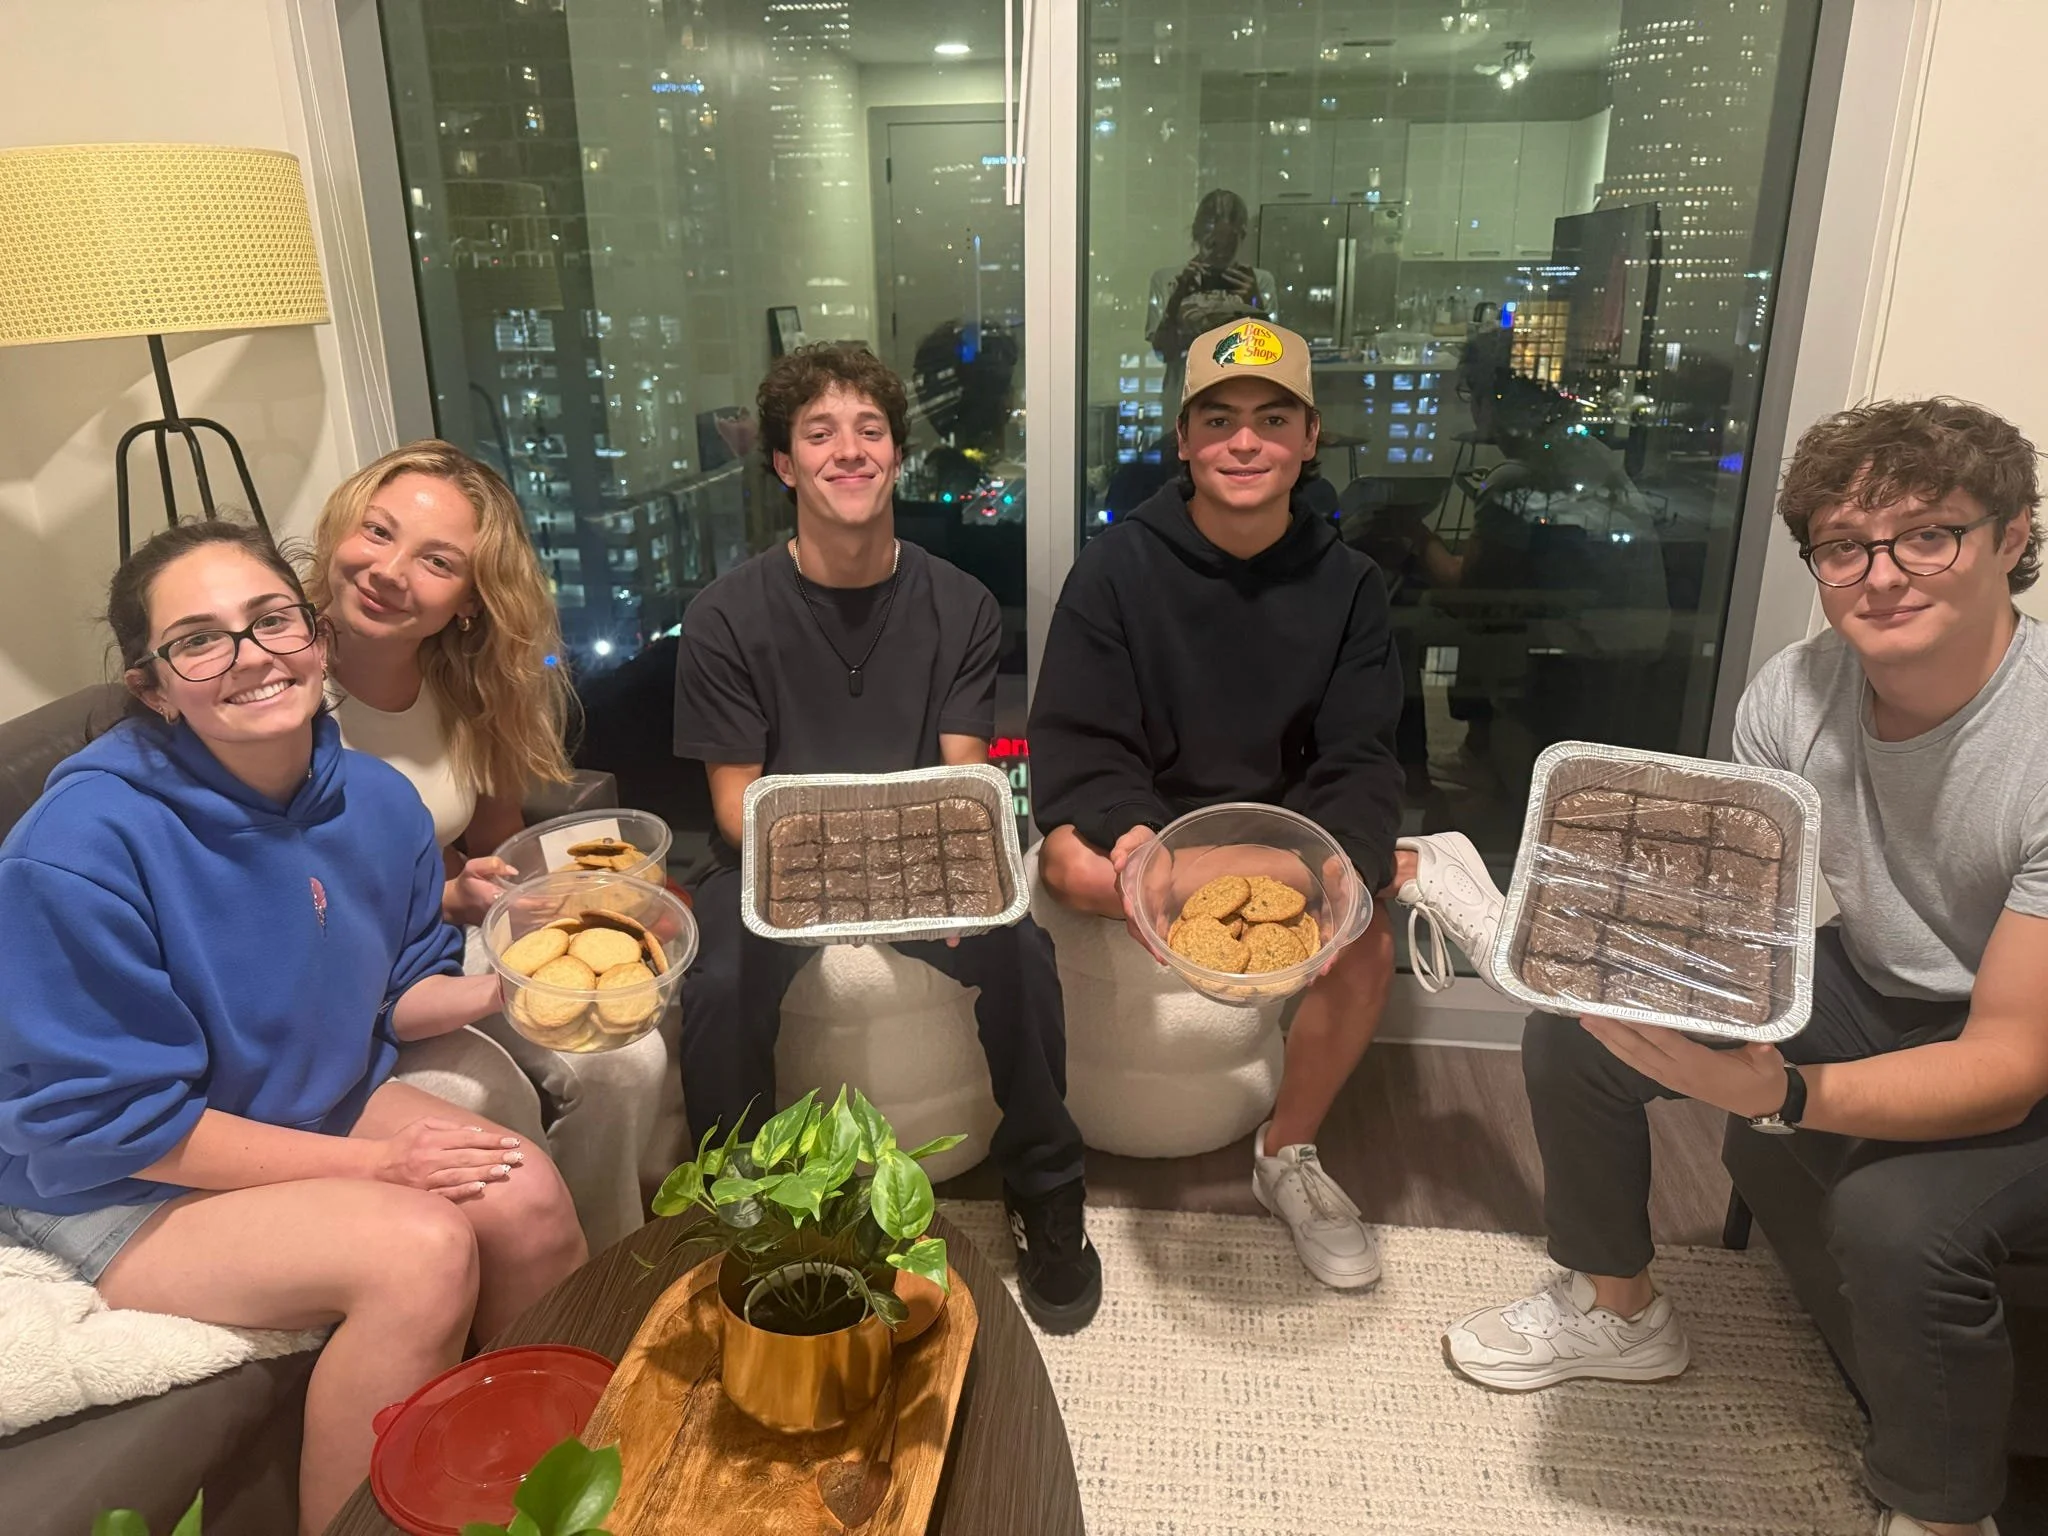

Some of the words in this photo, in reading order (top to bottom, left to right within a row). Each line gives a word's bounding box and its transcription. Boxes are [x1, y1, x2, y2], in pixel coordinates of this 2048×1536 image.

[1244, 325, 1271, 339] Bass
[1245, 336, 1265, 347] Pro
[1244, 346, 1278, 361] Shops
